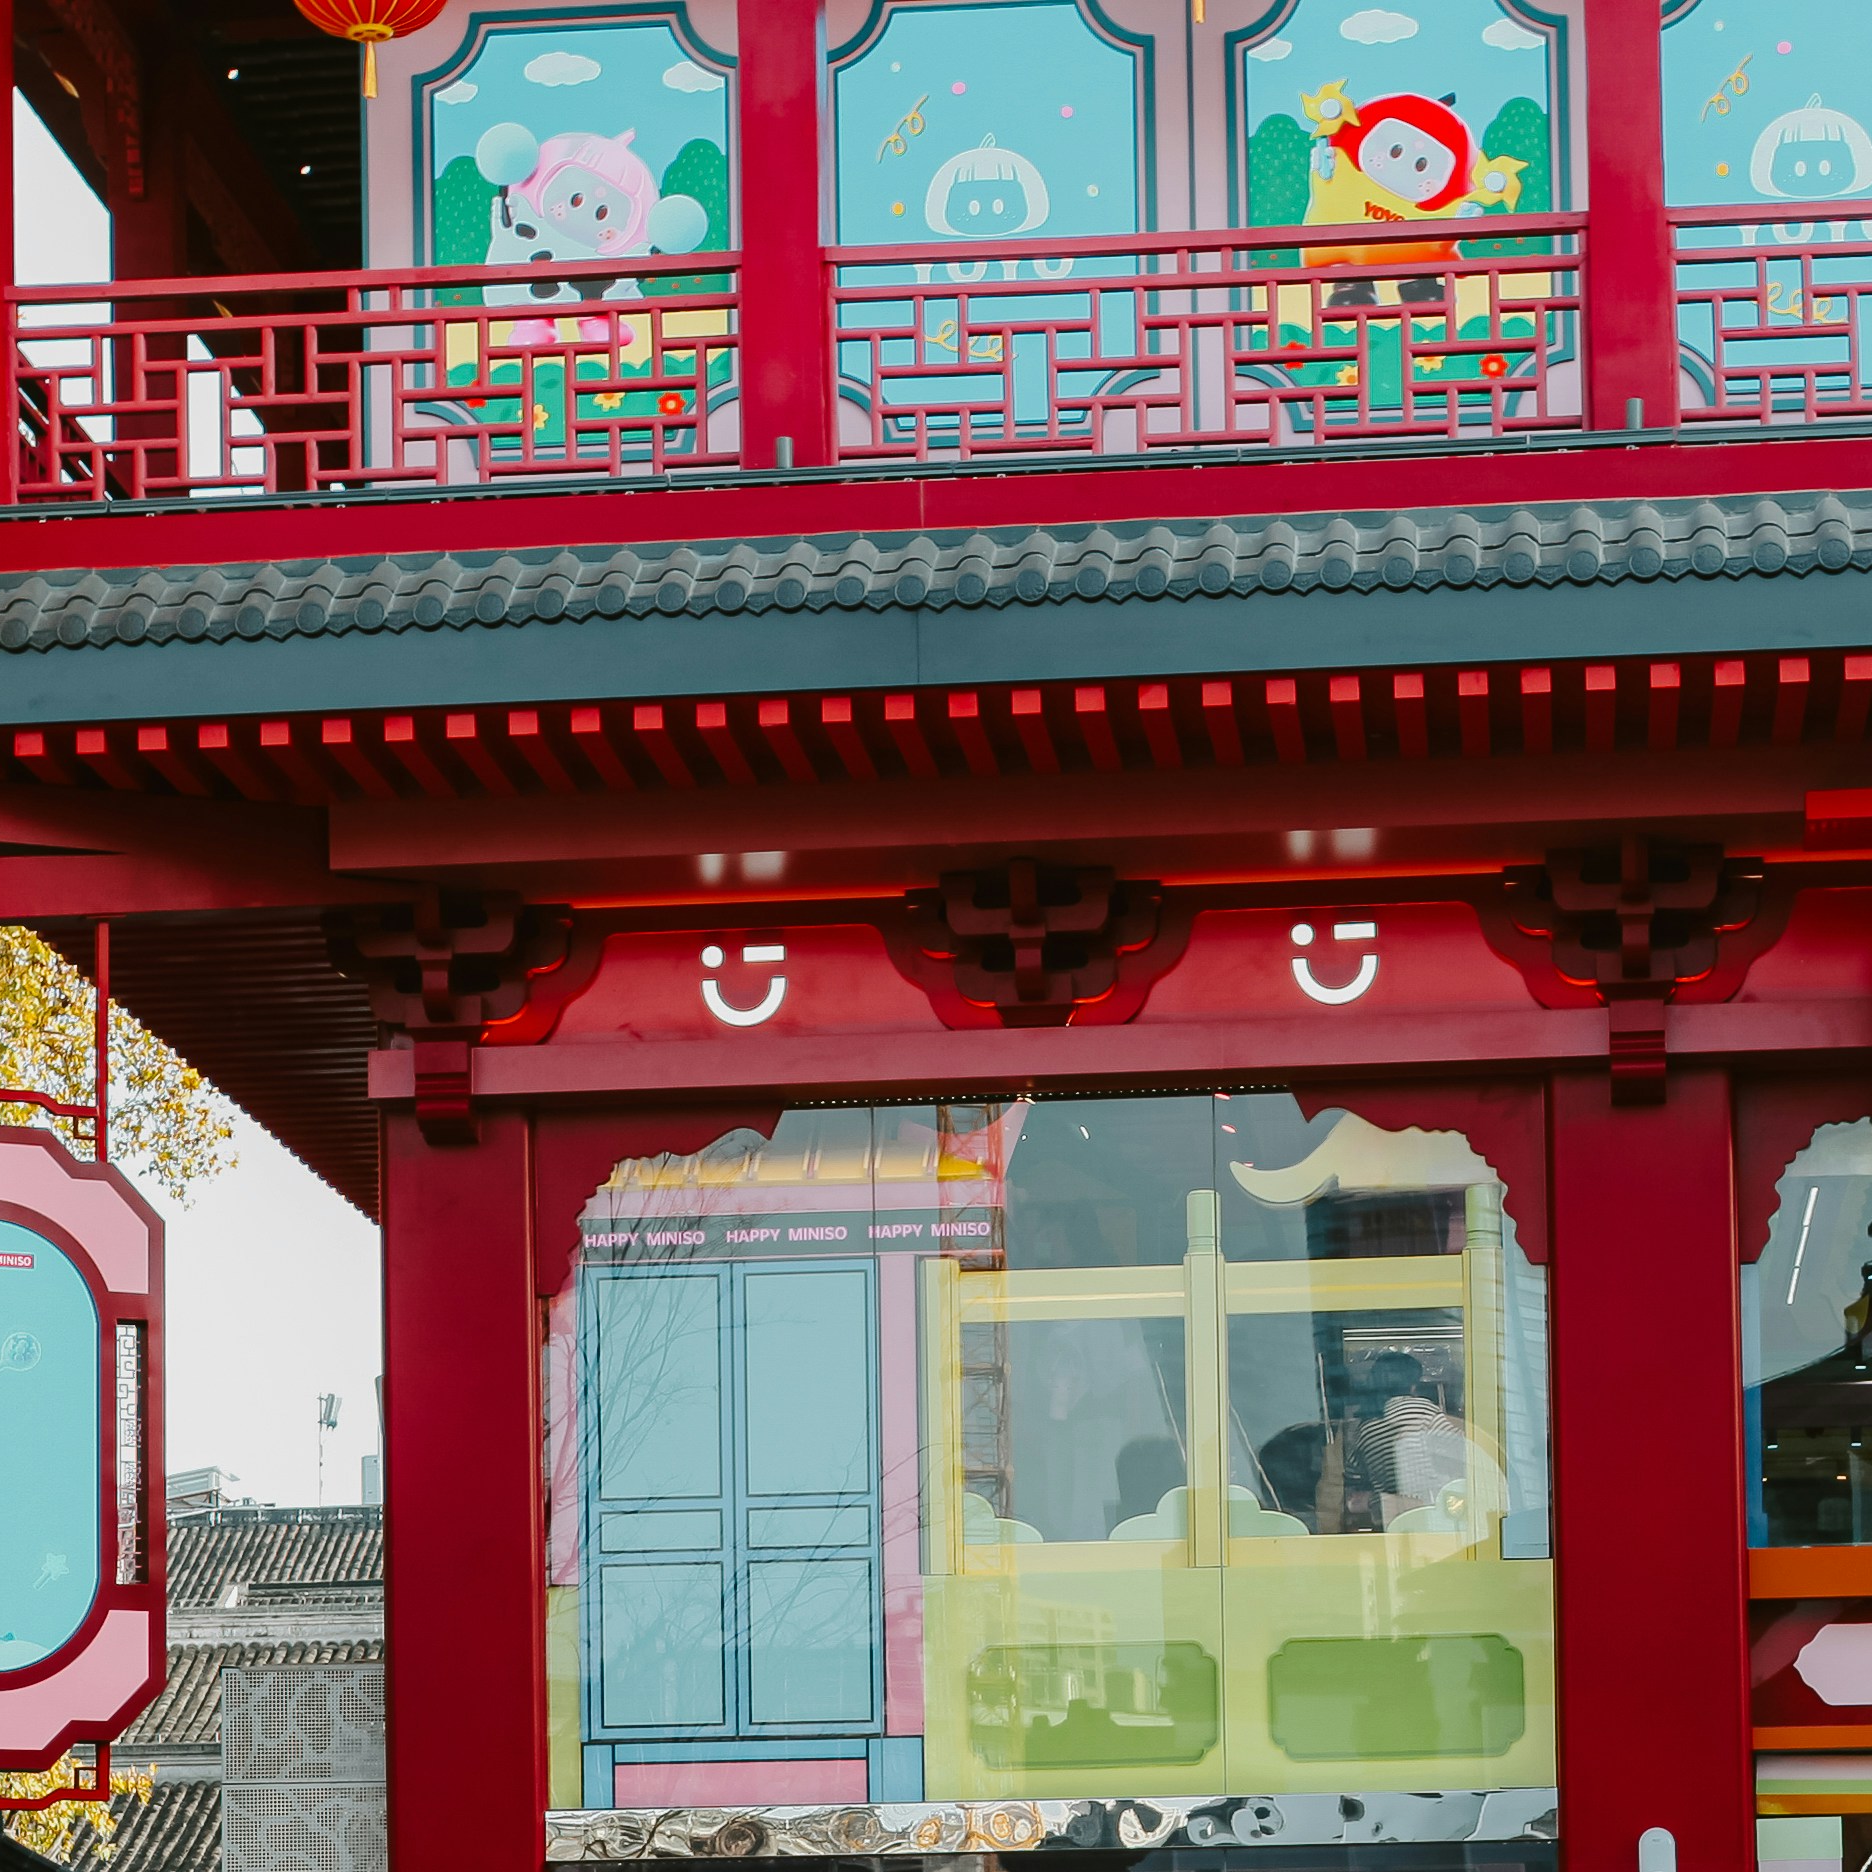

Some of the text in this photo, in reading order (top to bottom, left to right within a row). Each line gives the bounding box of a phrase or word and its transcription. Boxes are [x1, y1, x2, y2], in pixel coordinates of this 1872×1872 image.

[584, 1222, 991, 1248] HAPPY MINISO HAPPY MINISO HAPPY MINISO
